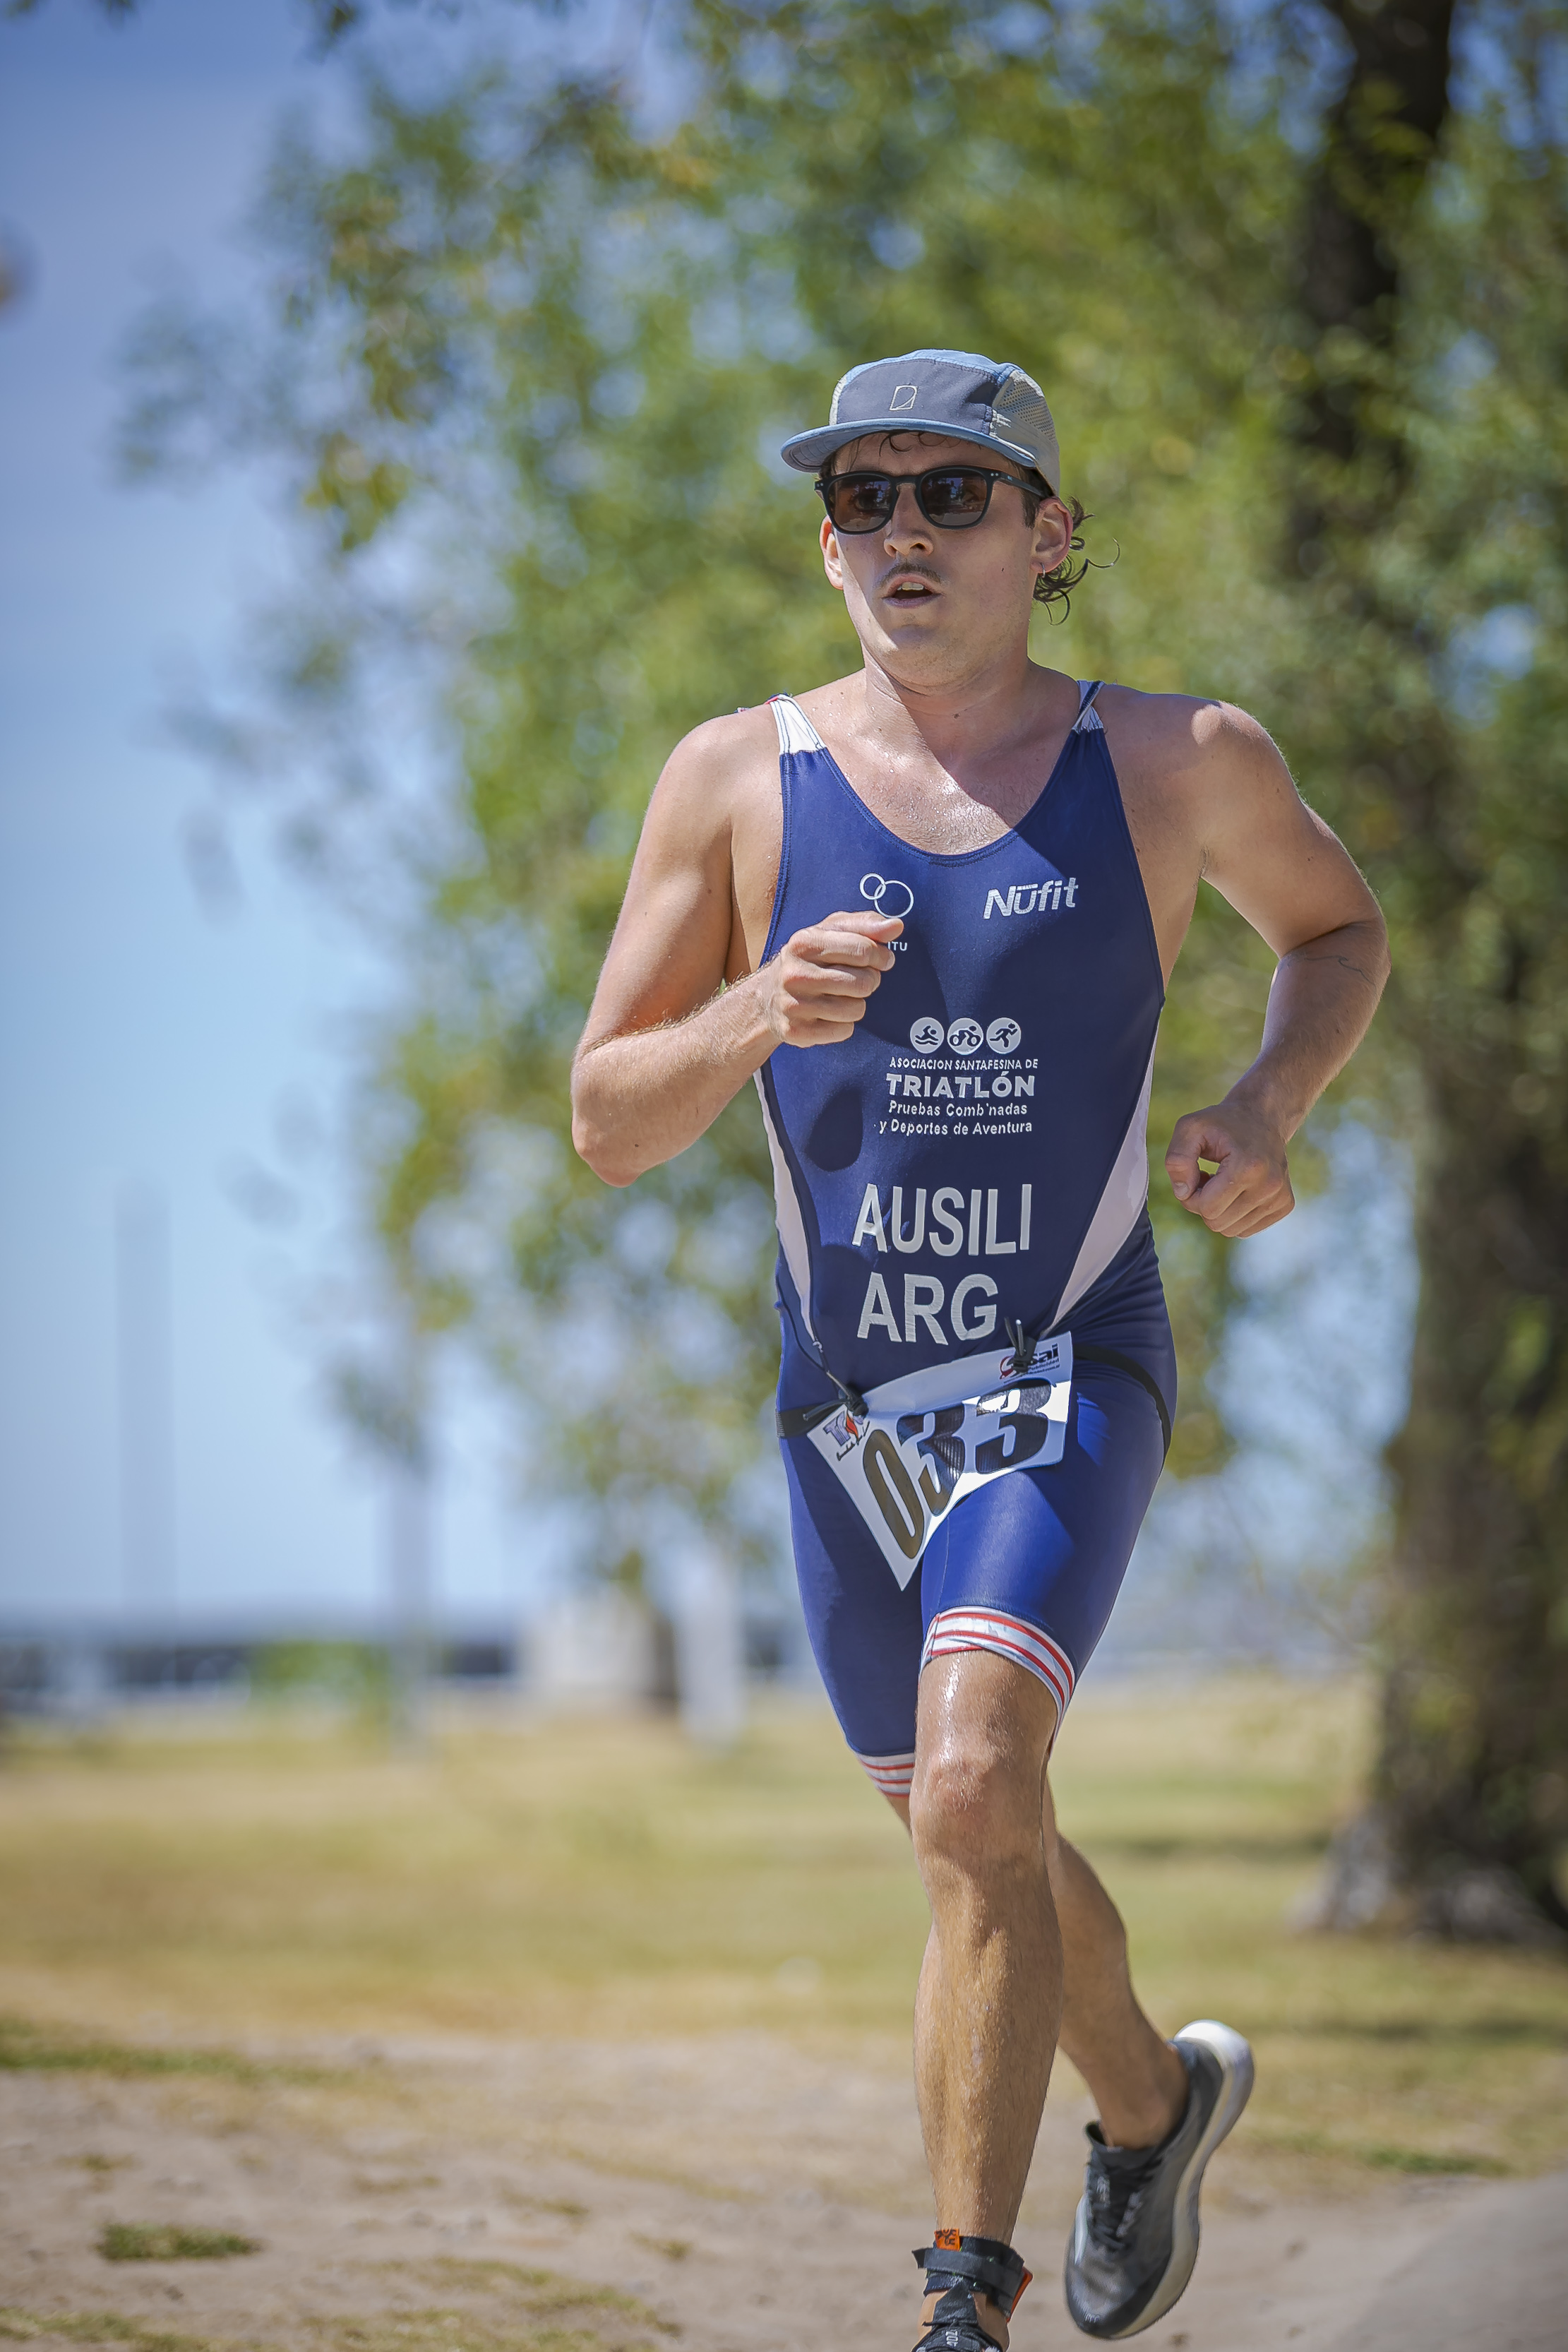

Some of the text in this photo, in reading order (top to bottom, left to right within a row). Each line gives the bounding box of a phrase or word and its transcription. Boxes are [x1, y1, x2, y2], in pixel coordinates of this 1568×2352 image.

[887, 941, 908, 952] ITU
[890, 1057, 1039, 1070] ASOCIACION SANTAFESINA DE
[886, 1071, 1036, 1099] TRIATLÓN
[889, 1100, 1028, 1116] Pruebas Combnadas
[880, 1118, 1032, 1136] y Deportes de Aventura
[852, 1183, 1032, 1257] AUSILI
[857, 1272, 998, 1345] ARG
[863, 1378, 1052, 1559] 033
